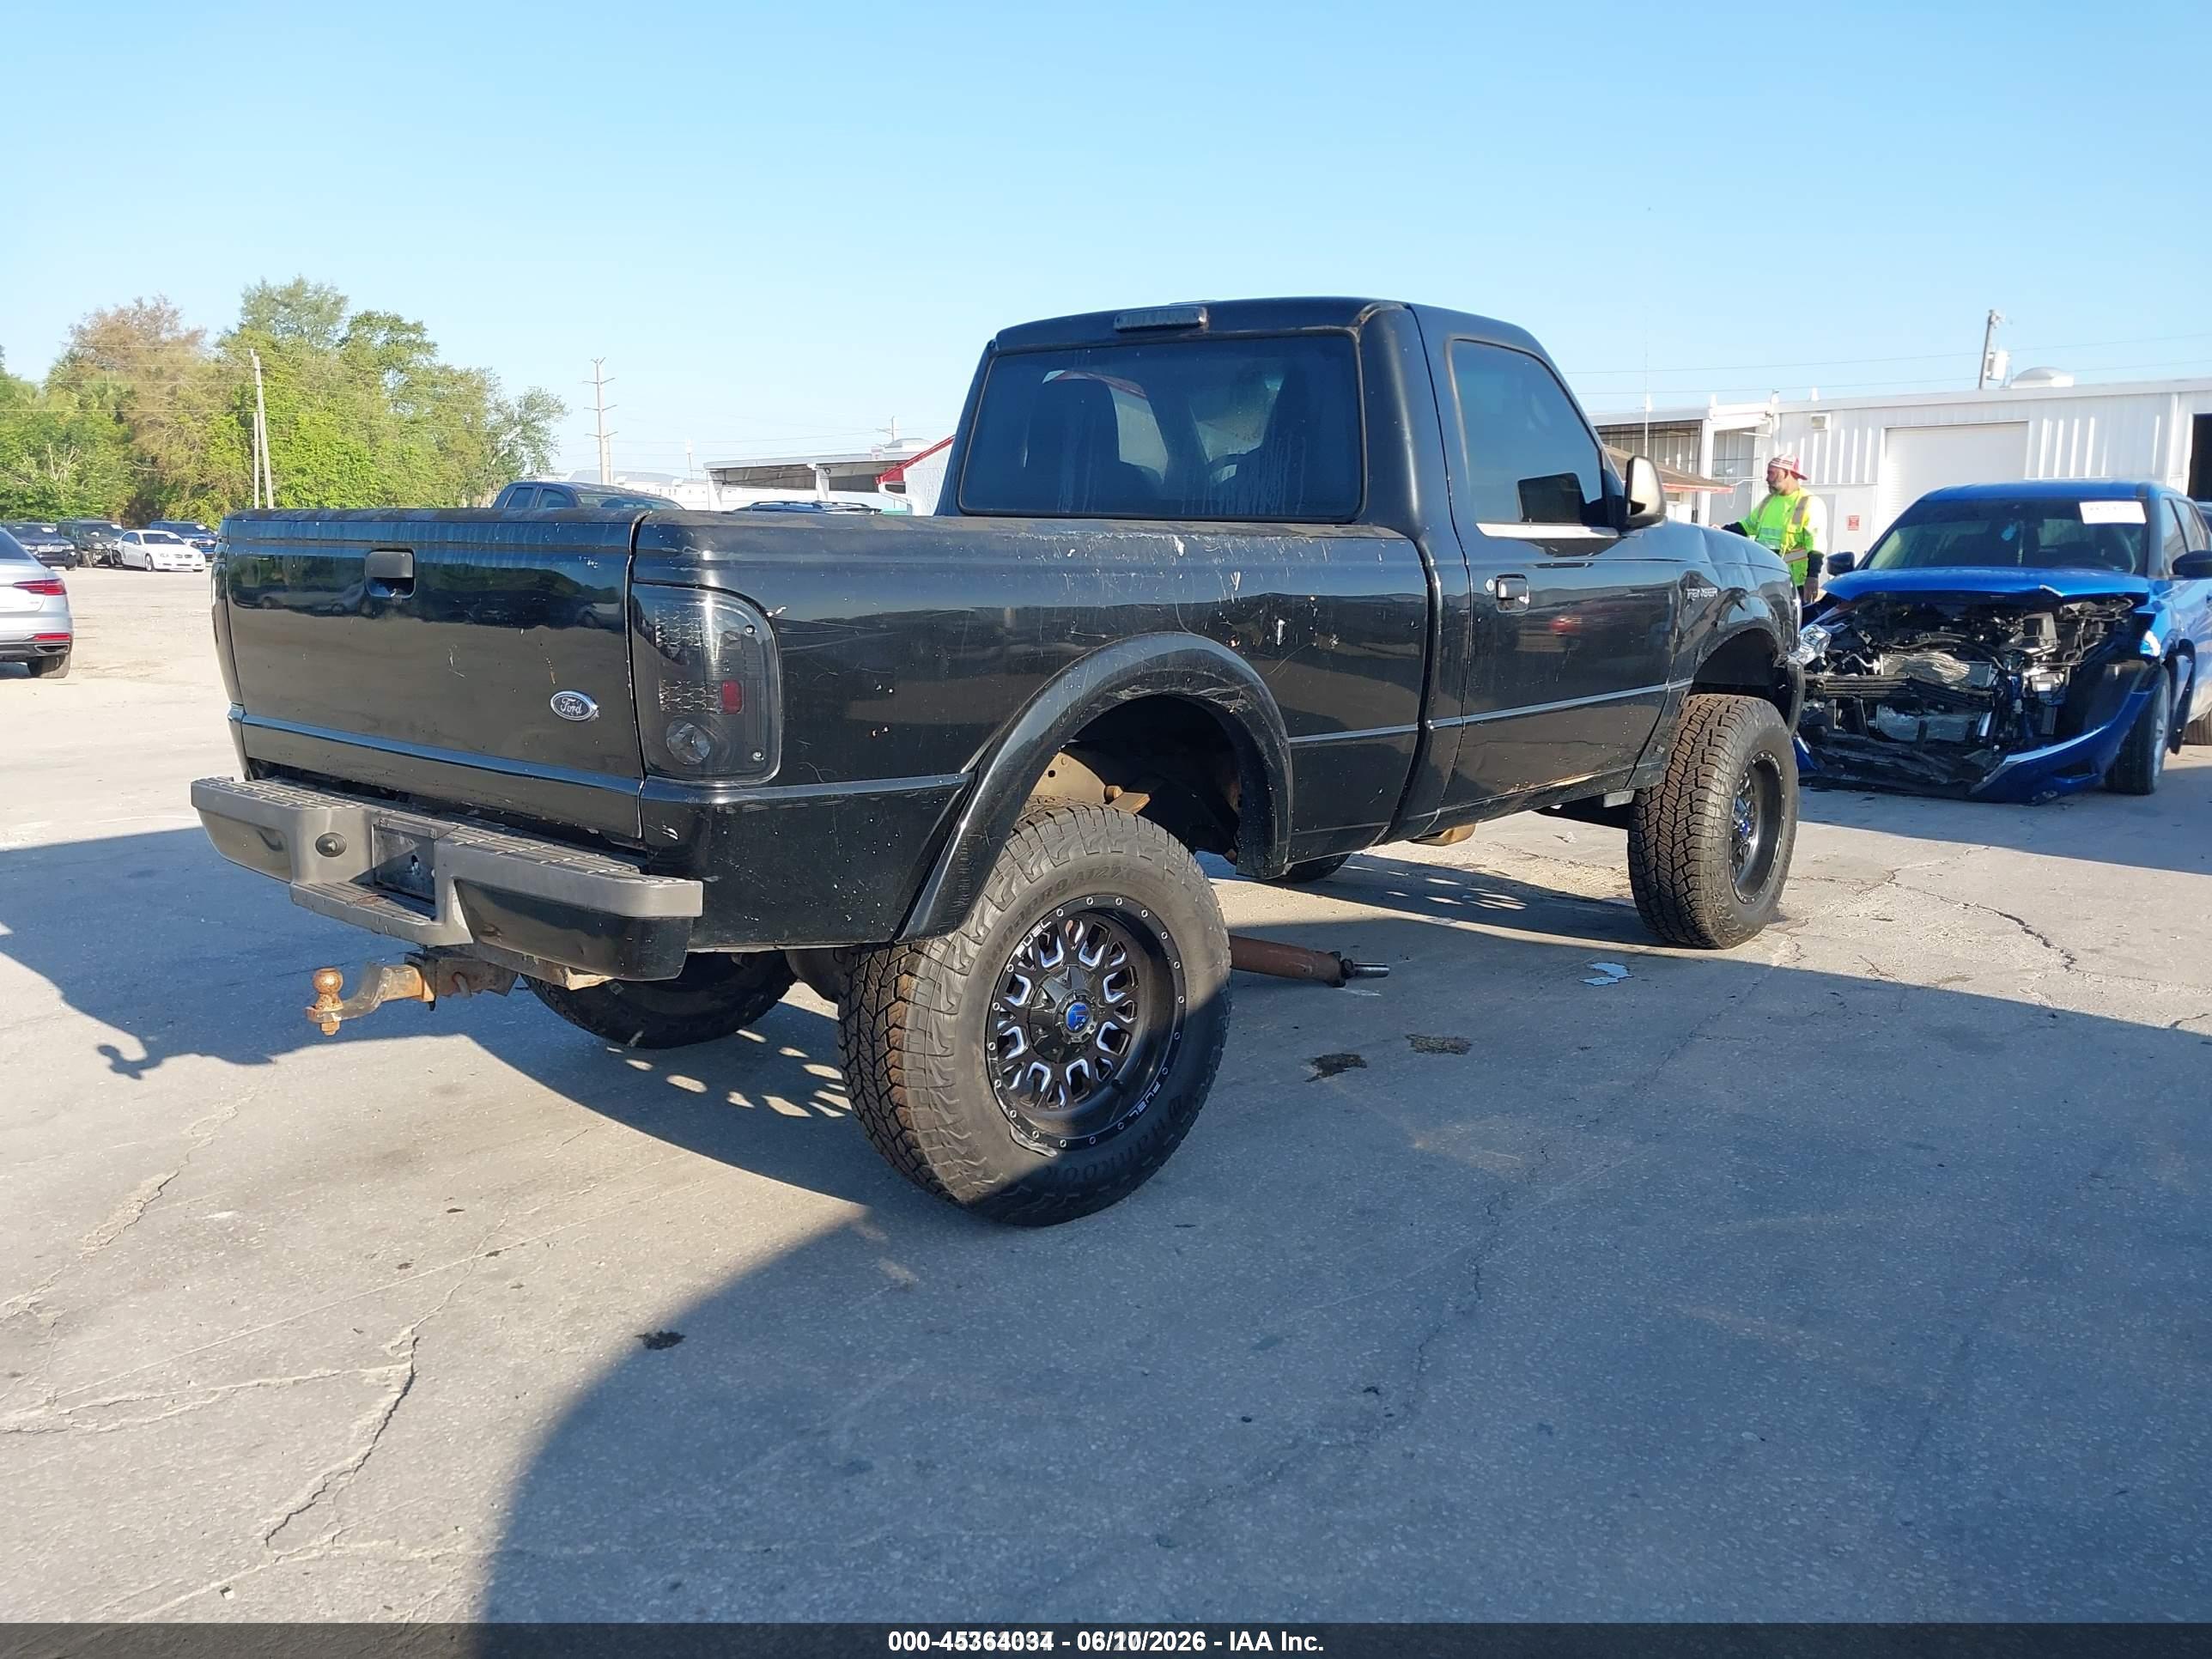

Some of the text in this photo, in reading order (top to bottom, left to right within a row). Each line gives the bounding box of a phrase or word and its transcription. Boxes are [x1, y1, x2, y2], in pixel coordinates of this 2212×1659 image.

[560, 696, 584, 716] Ford
[1016, 920, 1052, 957] FUEL
[1128, 1080, 1161, 1117] FUEL
